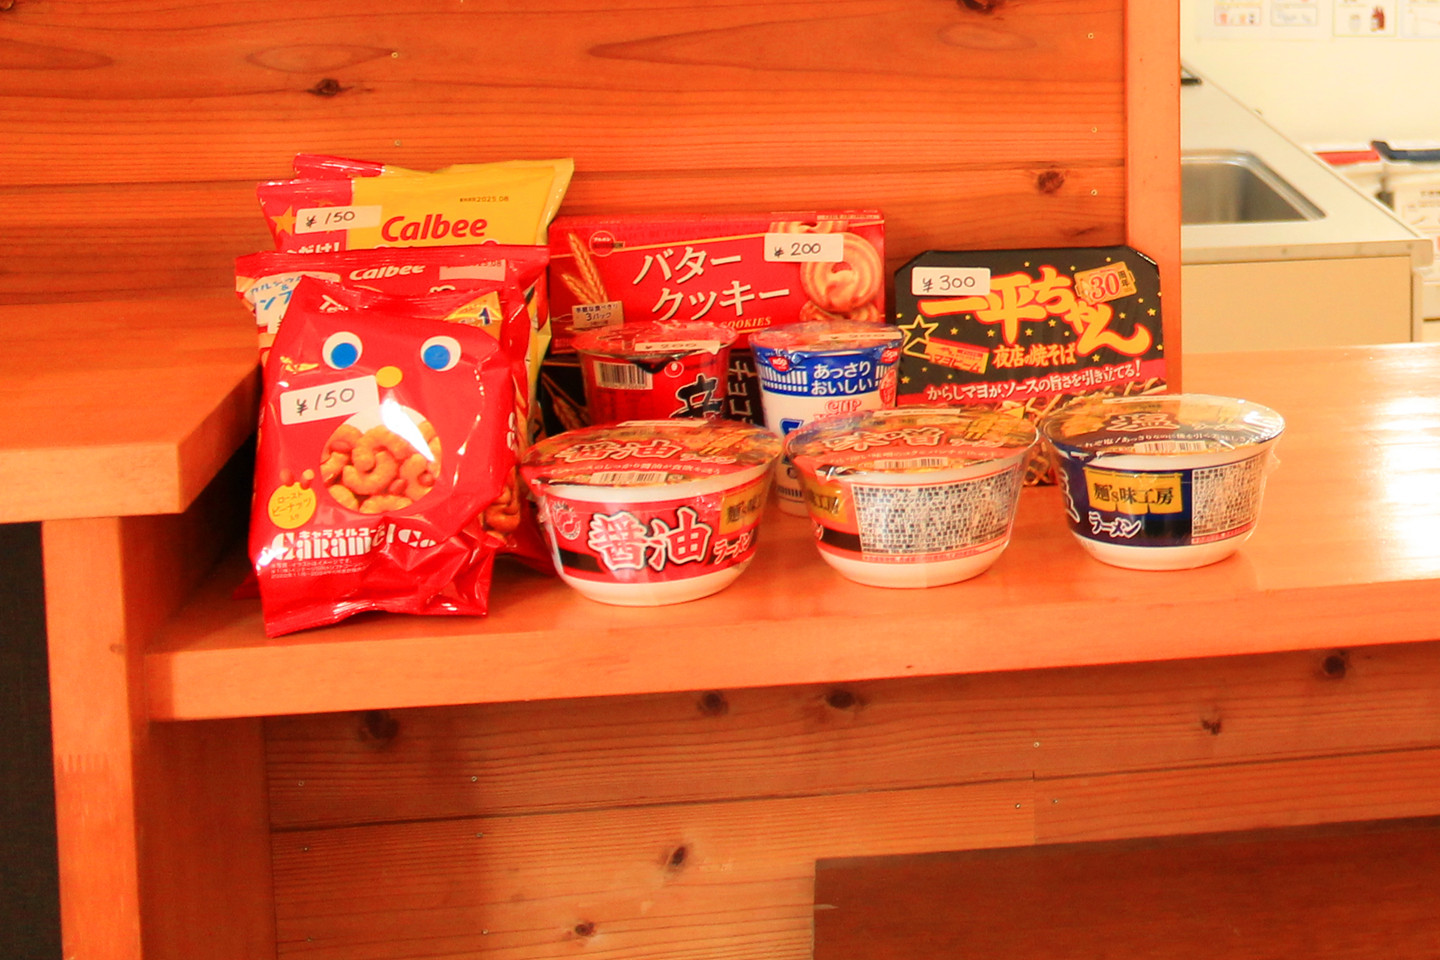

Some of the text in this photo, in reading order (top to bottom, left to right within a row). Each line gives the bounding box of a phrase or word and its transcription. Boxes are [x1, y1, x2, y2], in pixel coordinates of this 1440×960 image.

[381, 213, 488, 242] Calbee
[349, 265, 426, 282] Calbee
[632, 245, 742, 286] バター
[651, 280, 790, 321] クッキー
[813, 361, 872, 380] あっさり
[811, 378, 873, 396] おいしい
[1088, 510, 1143, 538] ラーメン
[588, 506, 713, 572] 醤油
